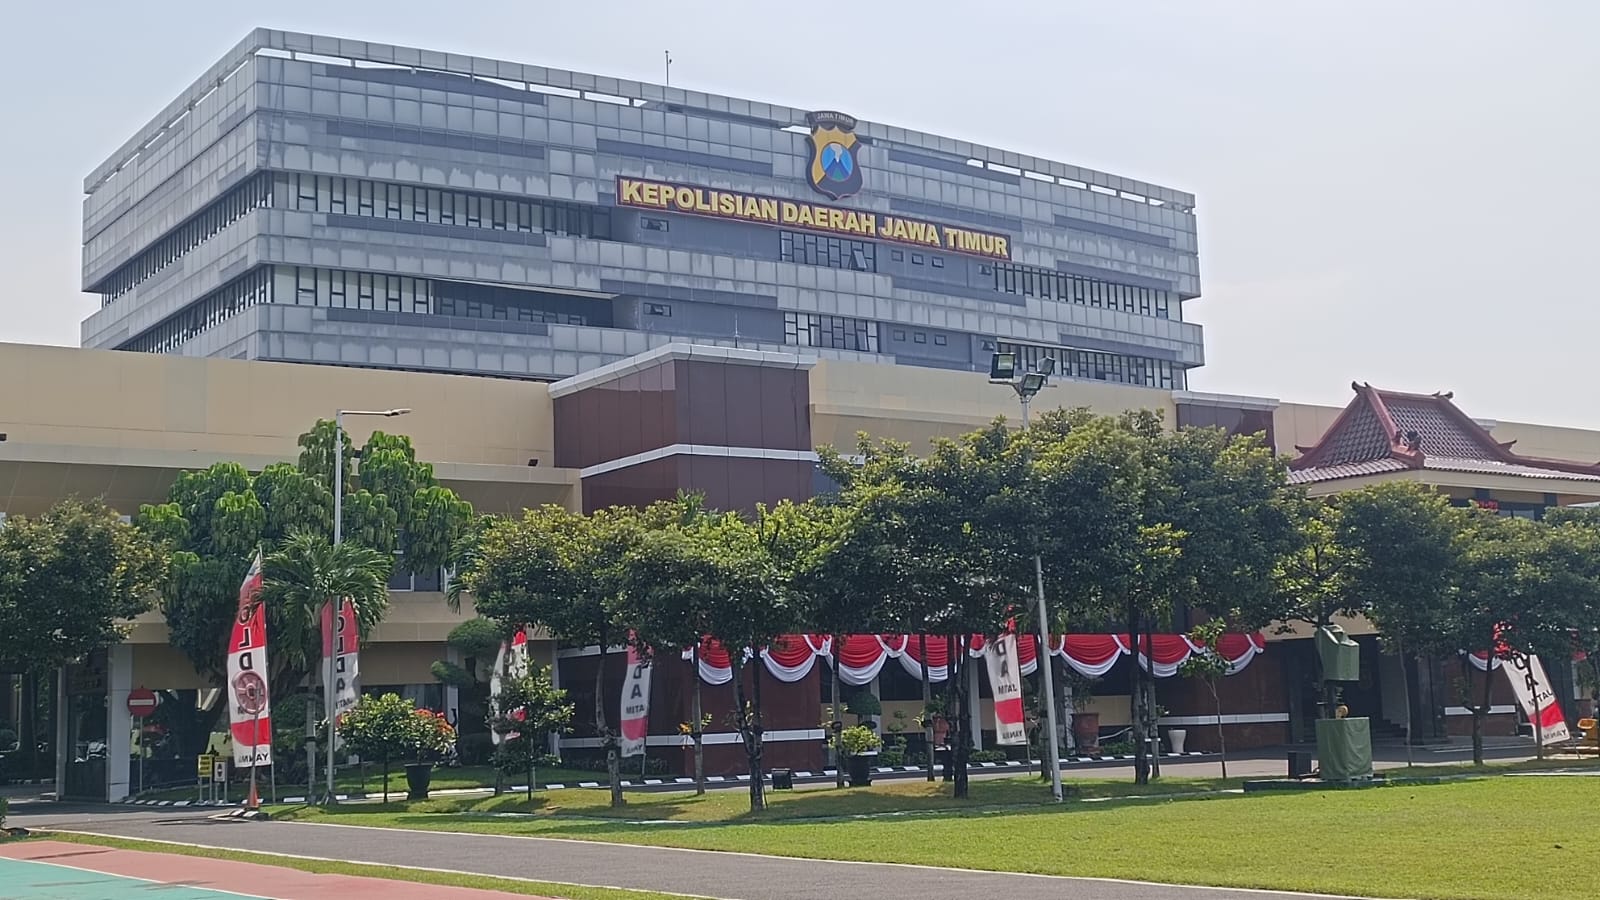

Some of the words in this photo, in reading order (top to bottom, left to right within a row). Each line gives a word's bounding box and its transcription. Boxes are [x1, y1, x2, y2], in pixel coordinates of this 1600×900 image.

[622, 179, 778, 221] KEPOLISIAN
[783, 202, 876, 235] DAERAH
[880, 217, 940, 246] JAWA
[944, 227, 1008, 256] TIMUR
